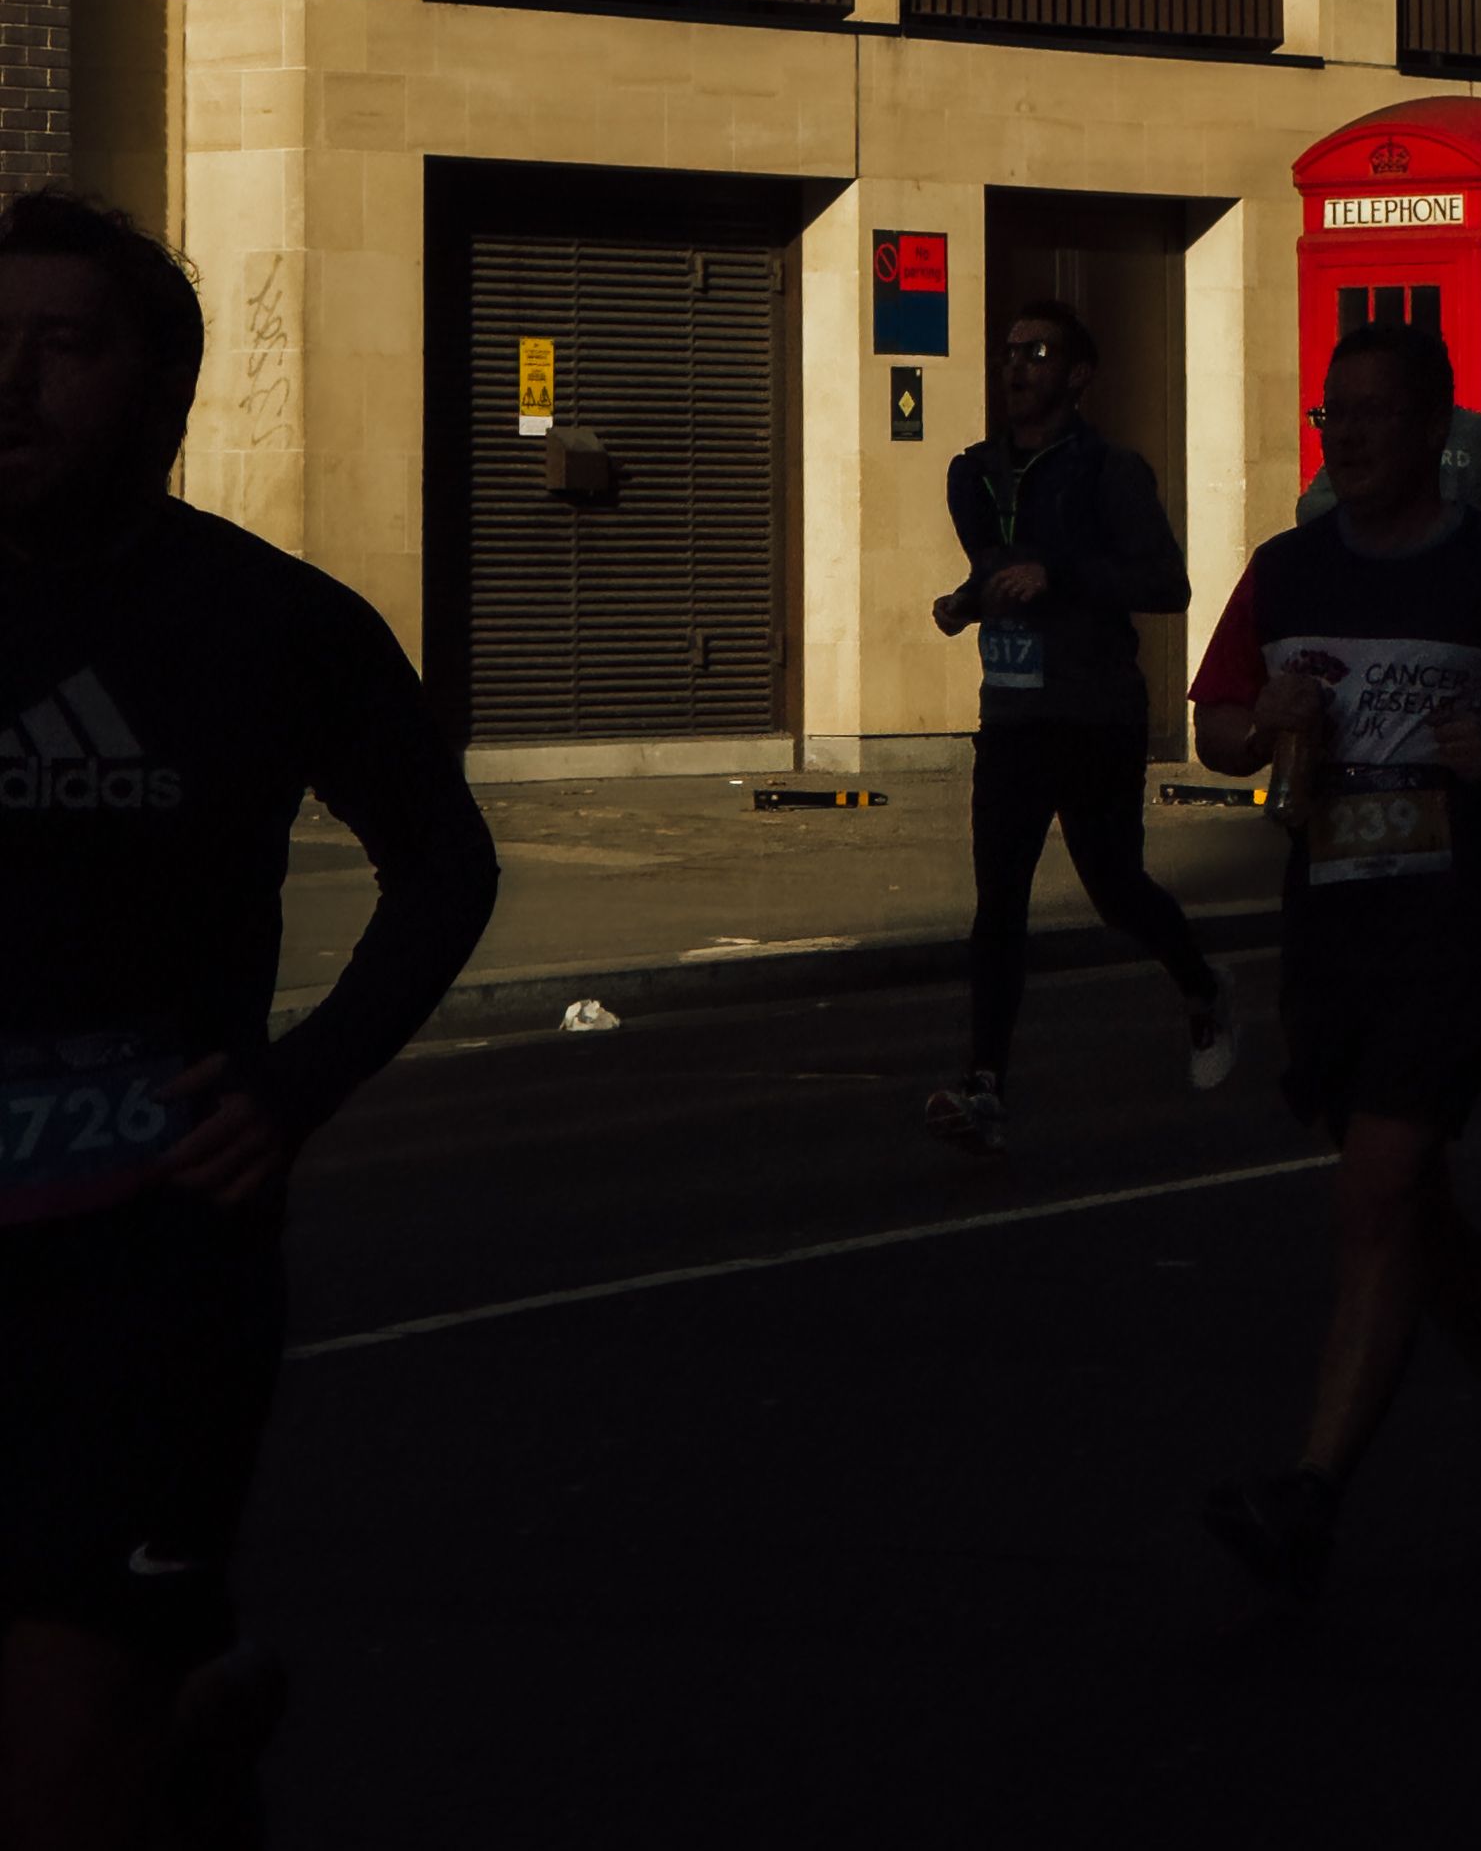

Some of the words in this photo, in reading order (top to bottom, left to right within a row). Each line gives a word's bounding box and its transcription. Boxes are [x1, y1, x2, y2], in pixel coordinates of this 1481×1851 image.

[1327, 196, 1462, 226] TELEPHONE
[1365, 663, 1469, 690] CANCER
[1352, 715, 1387, 739] UK
[0, 1078, 167, 1161] 726
